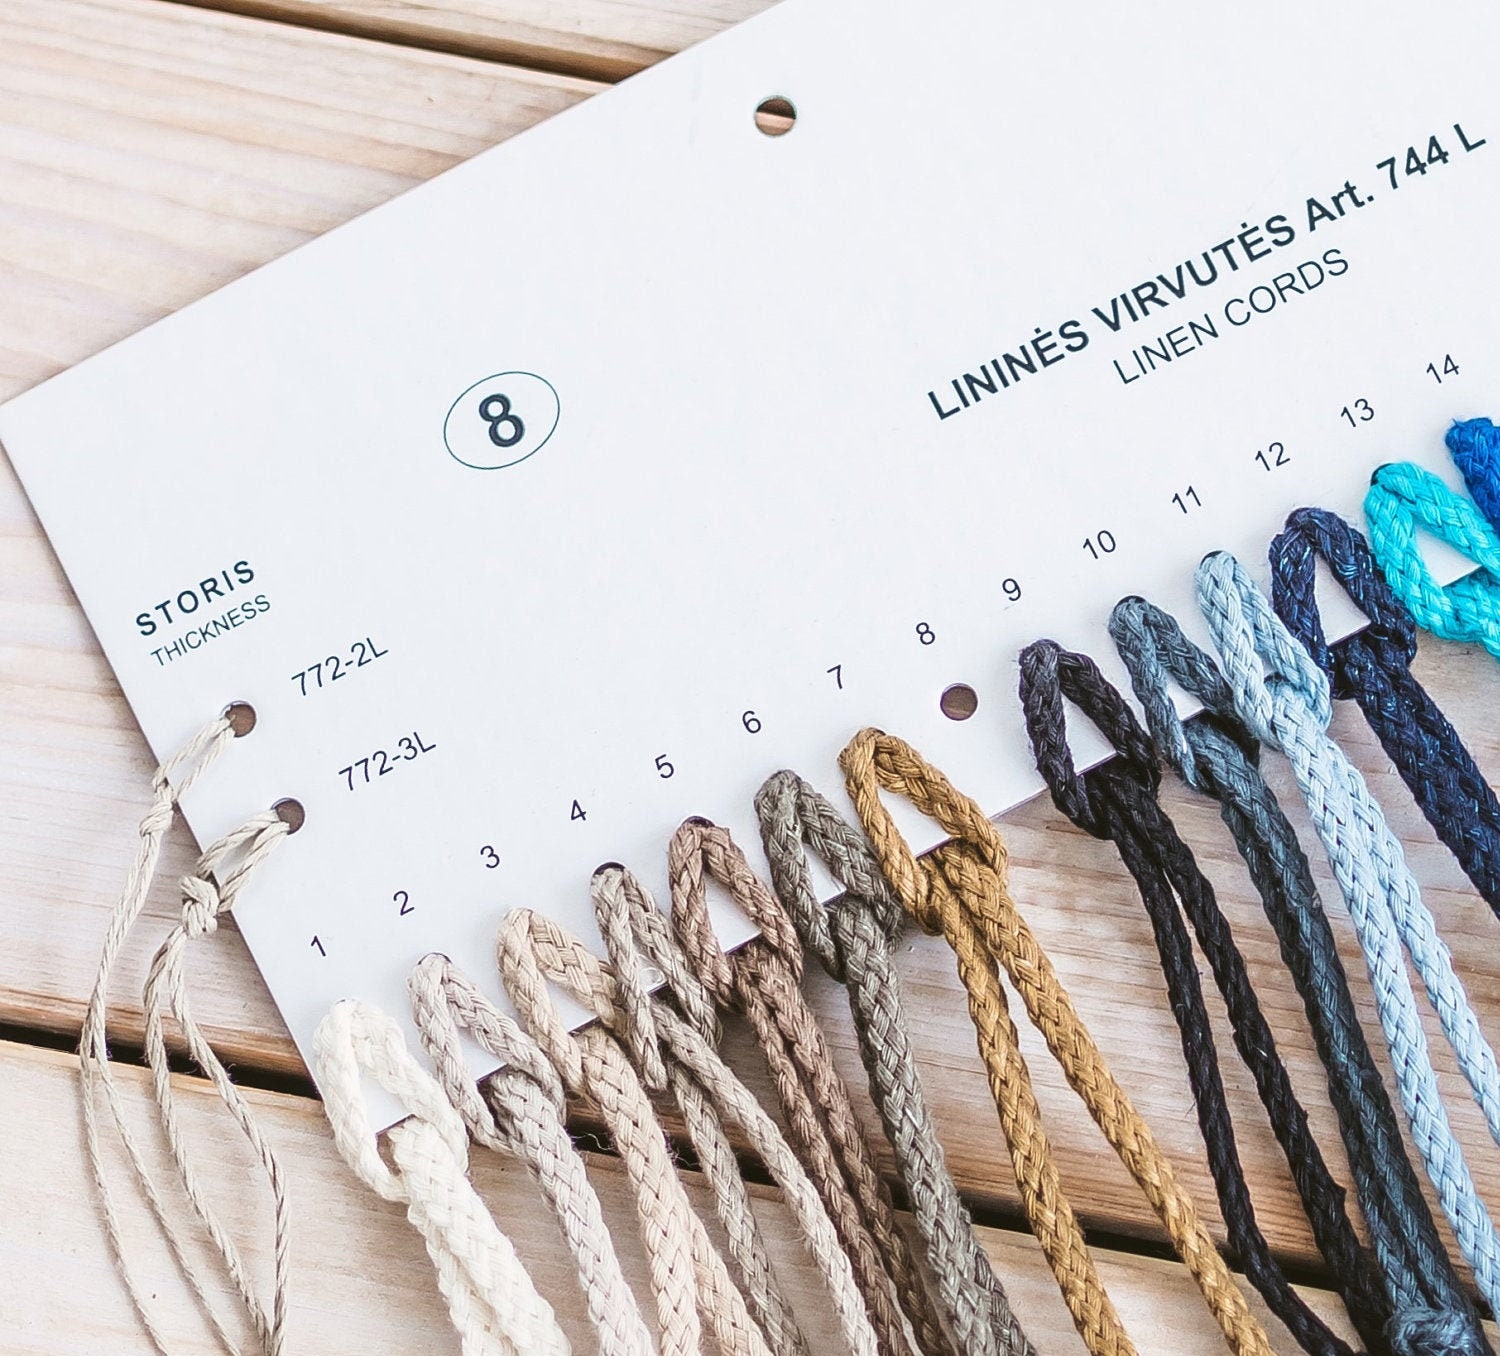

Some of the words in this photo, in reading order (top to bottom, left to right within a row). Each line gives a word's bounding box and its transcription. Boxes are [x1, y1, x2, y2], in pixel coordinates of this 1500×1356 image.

[927, 318, 1090, 421] LININĖS
[1091, 214, 1296, 332] VIRVUTĖS
[1306, 178, 1375, 233] Art.
[1376, 135, 1449, 190] 744
[1453, 122, 1487, 153] L
[1112, 312, 1219, 386] LINEN
[1224, 248, 1349, 327] CORDS
[478, 393, 525, 448] 8
[135, 560, 256, 636] STORIS
[150, 594, 271, 667] THICKNESS
[291, 636, 389, 697] 772-2L
[310, 935, 326, 957] 1
[393, 890, 415, 916] 2
[480, 845, 500, 869] 3
[570, 799, 587, 822] 4
[654, 753, 675, 779] 5
[742, 710, 762, 734] 6
[826, 664, 843, 690] 7
[915, 622, 936, 646] 8
[1002, 578, 1022, 602] 9
[1082, 529, 1117, 560] 10
[1171, 485, 1203, 515] 11
[1255, 441, 1291, 473] 12
[1340, 398, 1375, 429] 13
[1425, 353, 1460, 385] 14
[338, 730, 437, 791] 772-3L
